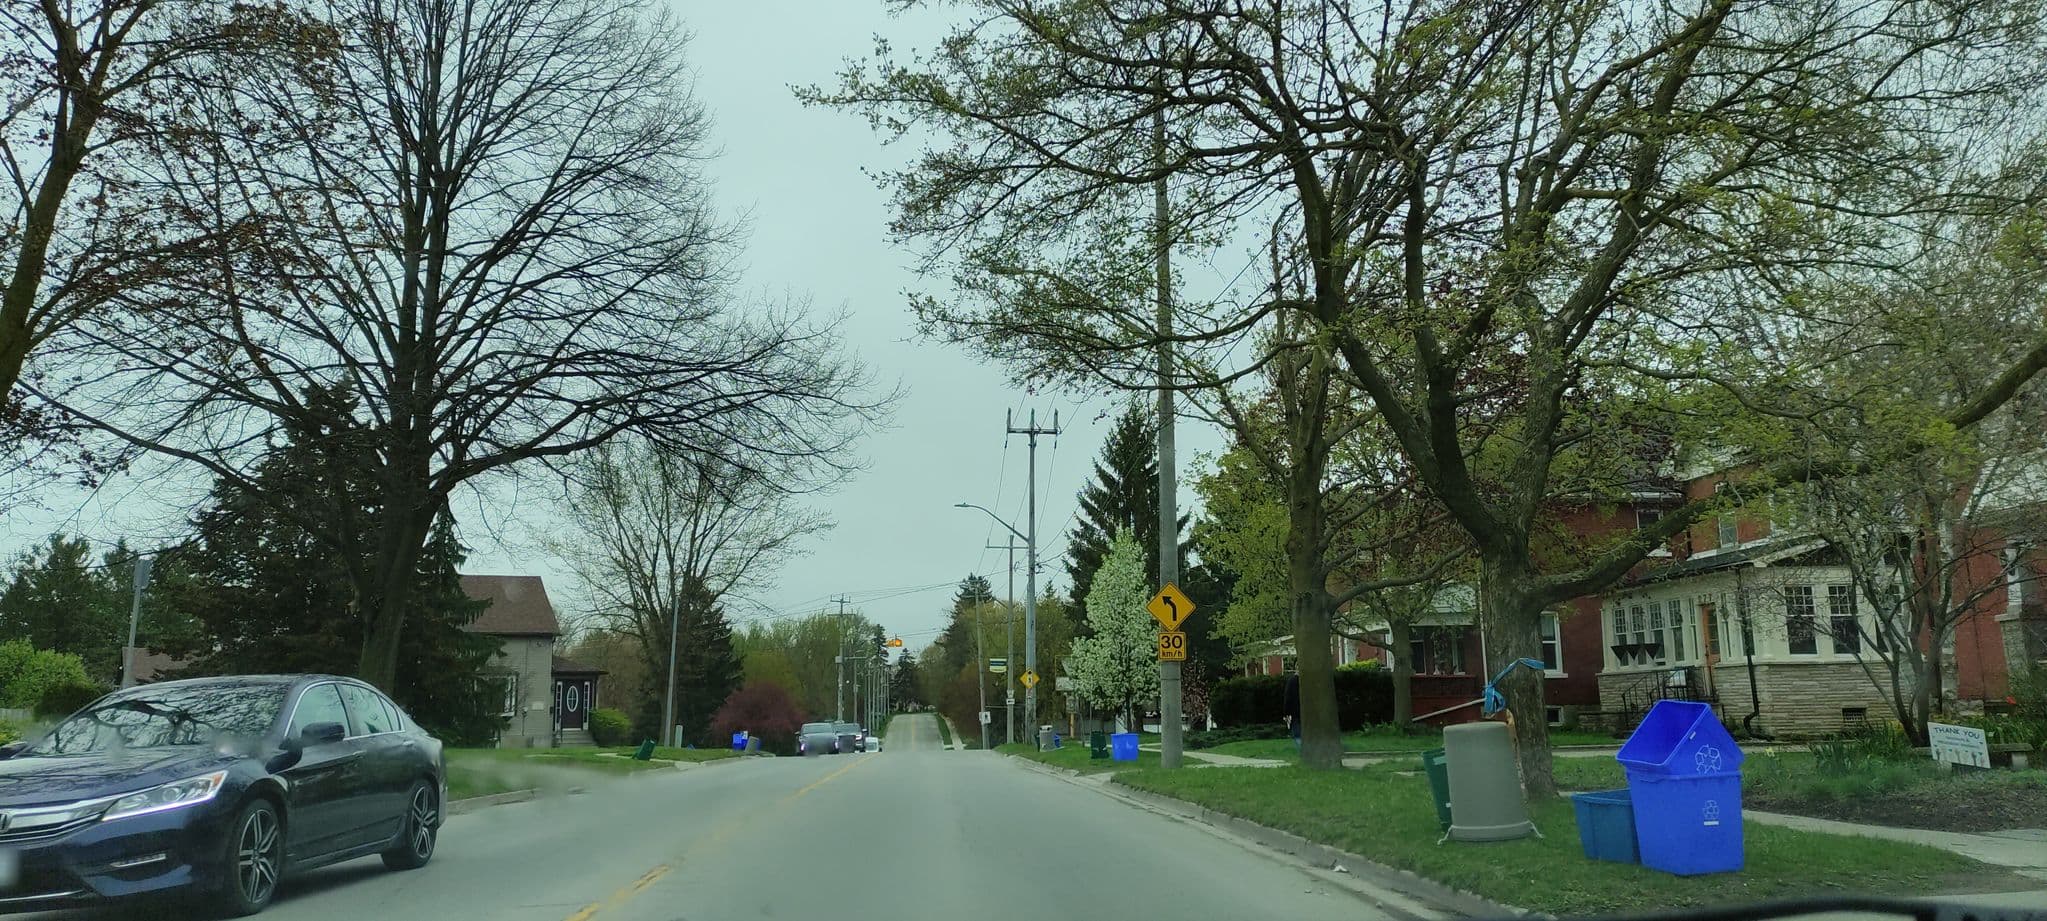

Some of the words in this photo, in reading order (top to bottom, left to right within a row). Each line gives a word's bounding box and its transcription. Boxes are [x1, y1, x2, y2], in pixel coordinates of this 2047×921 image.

[1161, 635, 1182, 649] 30
[1935, 727, 1960, 735] THANK
[1963, 730, 1980, 739] YOU
